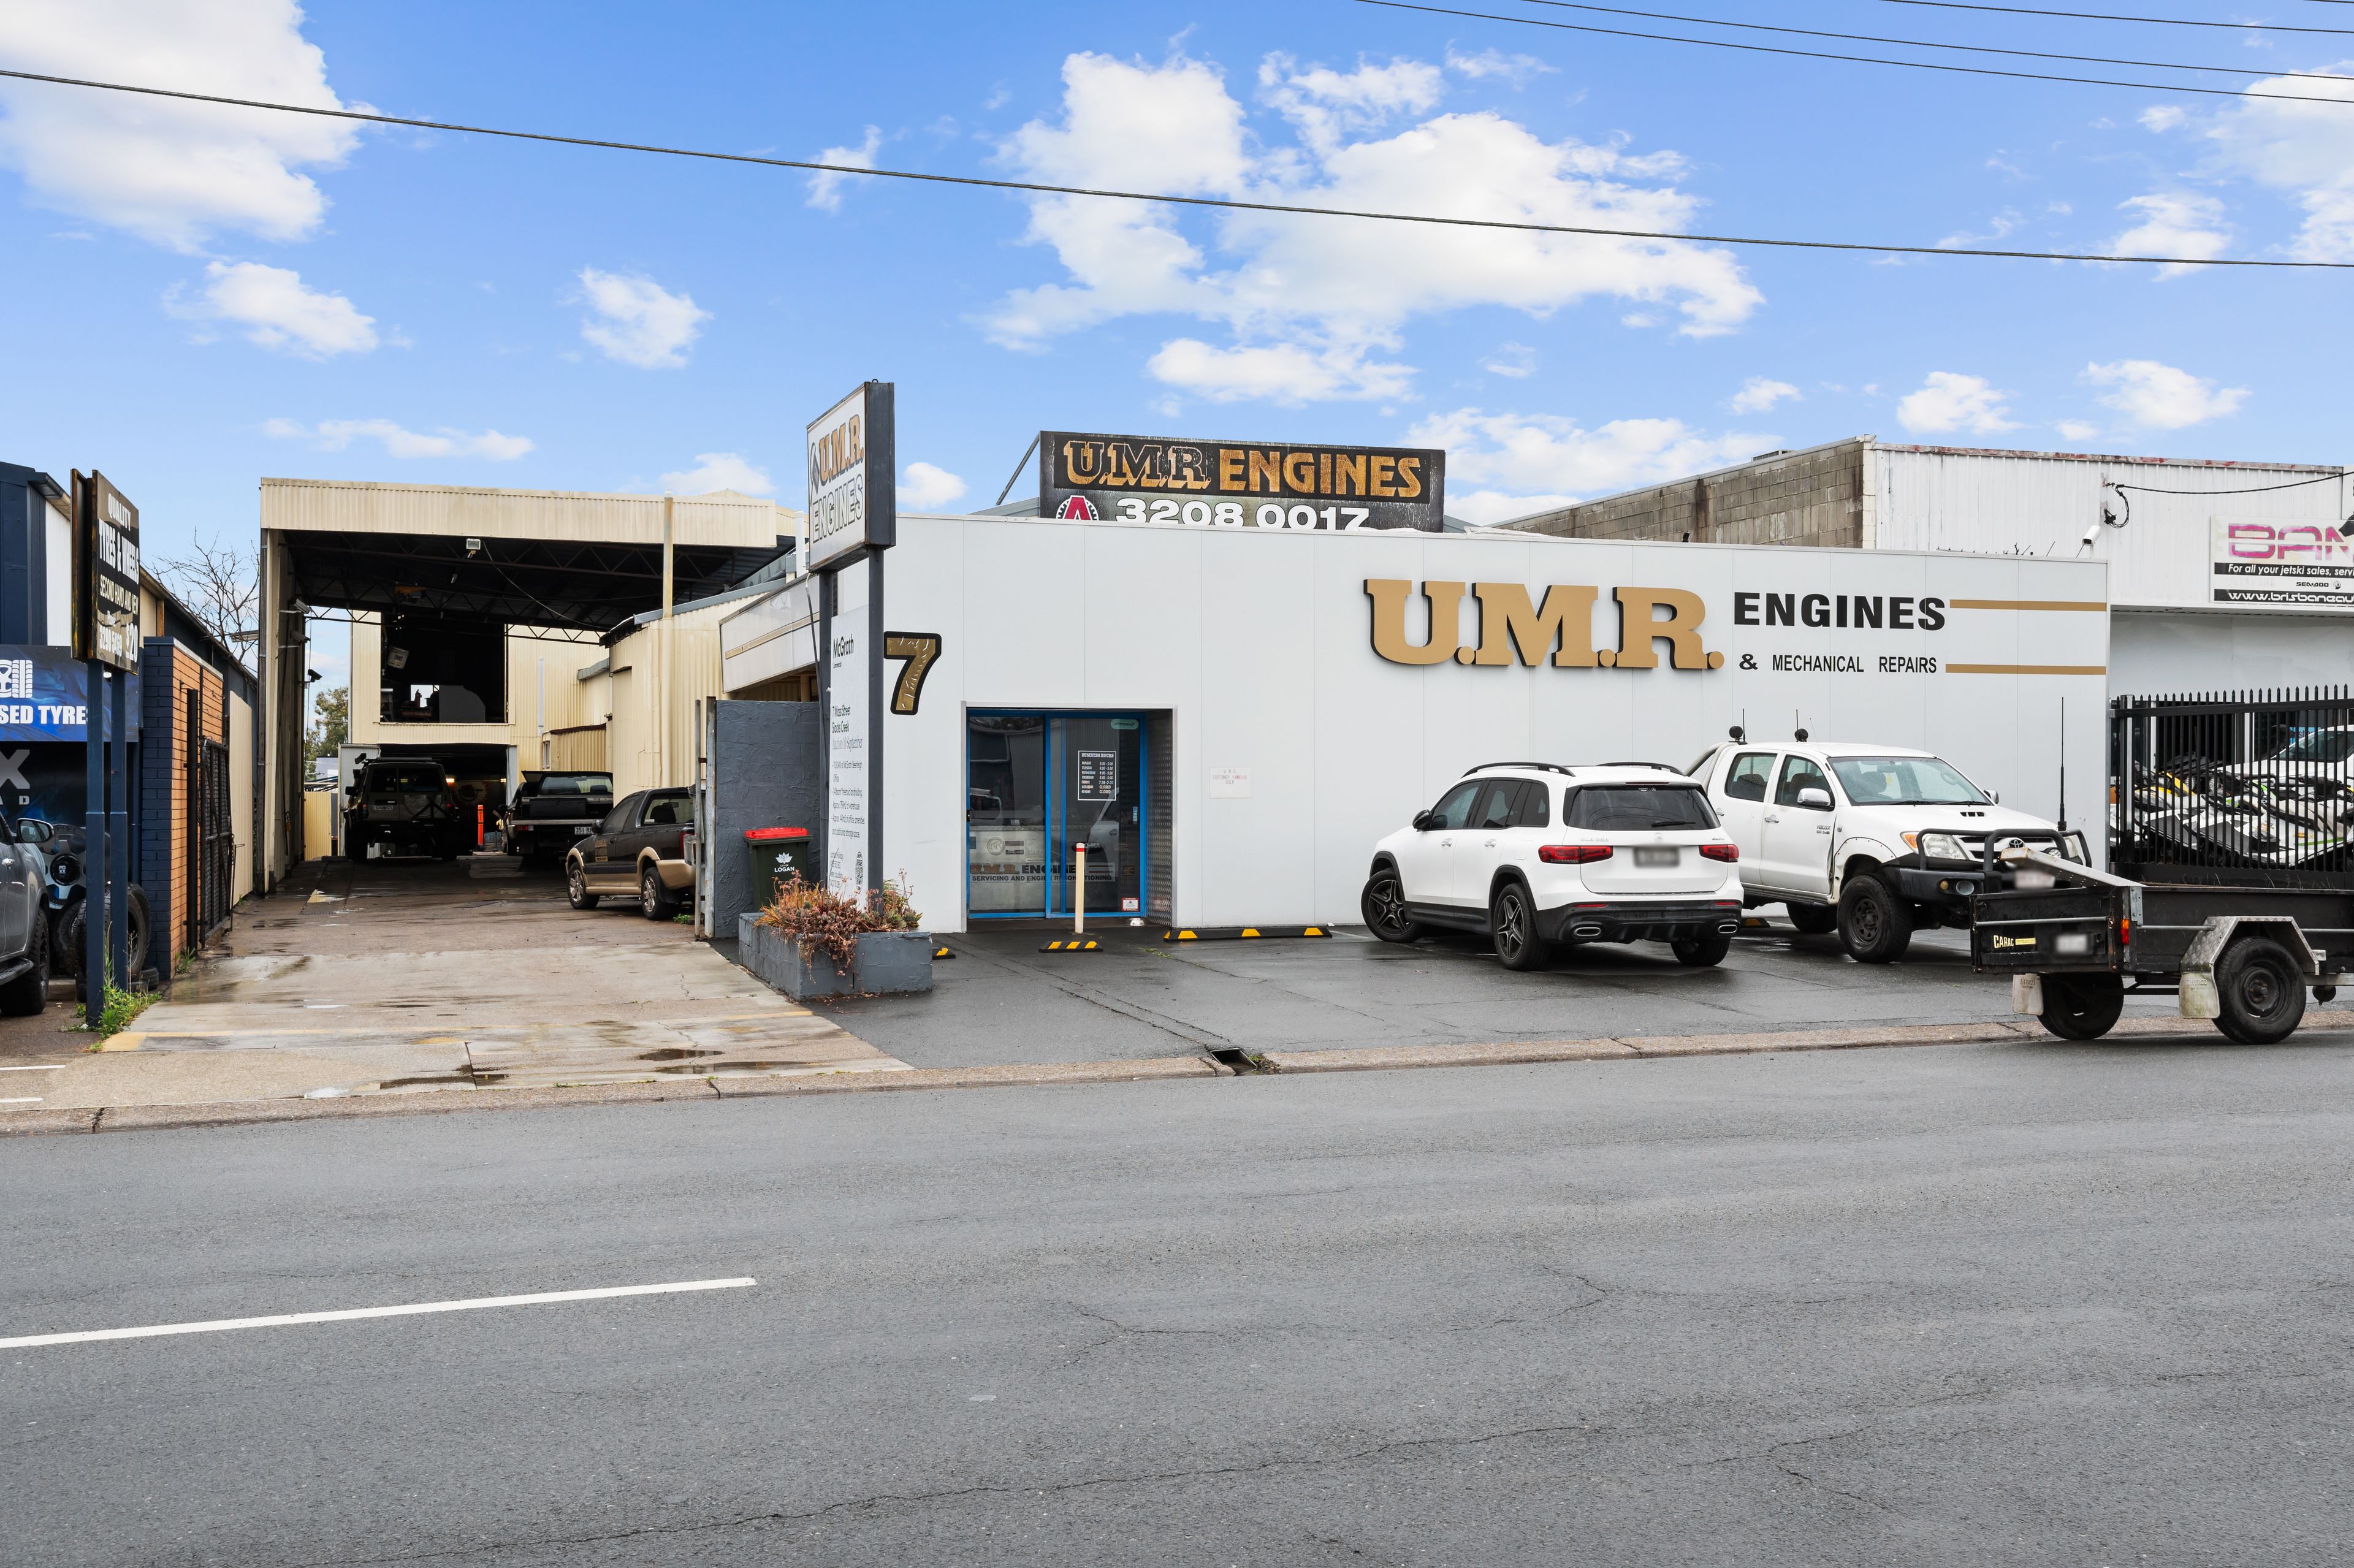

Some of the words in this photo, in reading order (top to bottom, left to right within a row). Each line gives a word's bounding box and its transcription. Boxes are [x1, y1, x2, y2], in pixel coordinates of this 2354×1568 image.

[1219, 449, 1421, 498] ENGINES
[108, 493, 131, 531] QUALITY
[813, 473, 863, 544] ENGINES
[1115, 497, 1244, 526] 3208
[1255, 503, 1370, 531] 0017
[99, 518, 116, 569] TYRES
[117, 531, 122, 572] &
[122, 536, 139, 585] WHEELS
[2228, 563, 2242, 573] For
[2245, 564, 2256, 574] all
[2258, 565, 2279, 576] your
[2280, 565, 2305, 576] jetski
[2306, 566, 2332, 576] sales,
[100, 574, 115, 602] SECOND
[115, 583, 124, 607] HAND
[2228, 592, 2354, 603] www.brisbaneau
[99, 625, 112, 652] 3290
[1363, 579, 1725, 669] U.M.R.
[1734, 592, 1945, 631] ENGINES
[126, 622, 139, 663] $20
[833, 633, 854, 659] McGrath
[883, 631, 942, 715] 7
[1739, 653, 1758, 671] &
[1772, 655, 1864, 672] MECHANICAL
[1878, 657, 1937, 674] REPAIRS
[38, 706, 88, 725] TYRE
[842, 704, 851, 716] Street
[841, 720, 850, 733] Creek
[1994, 935, 2014, 948] CARAC
